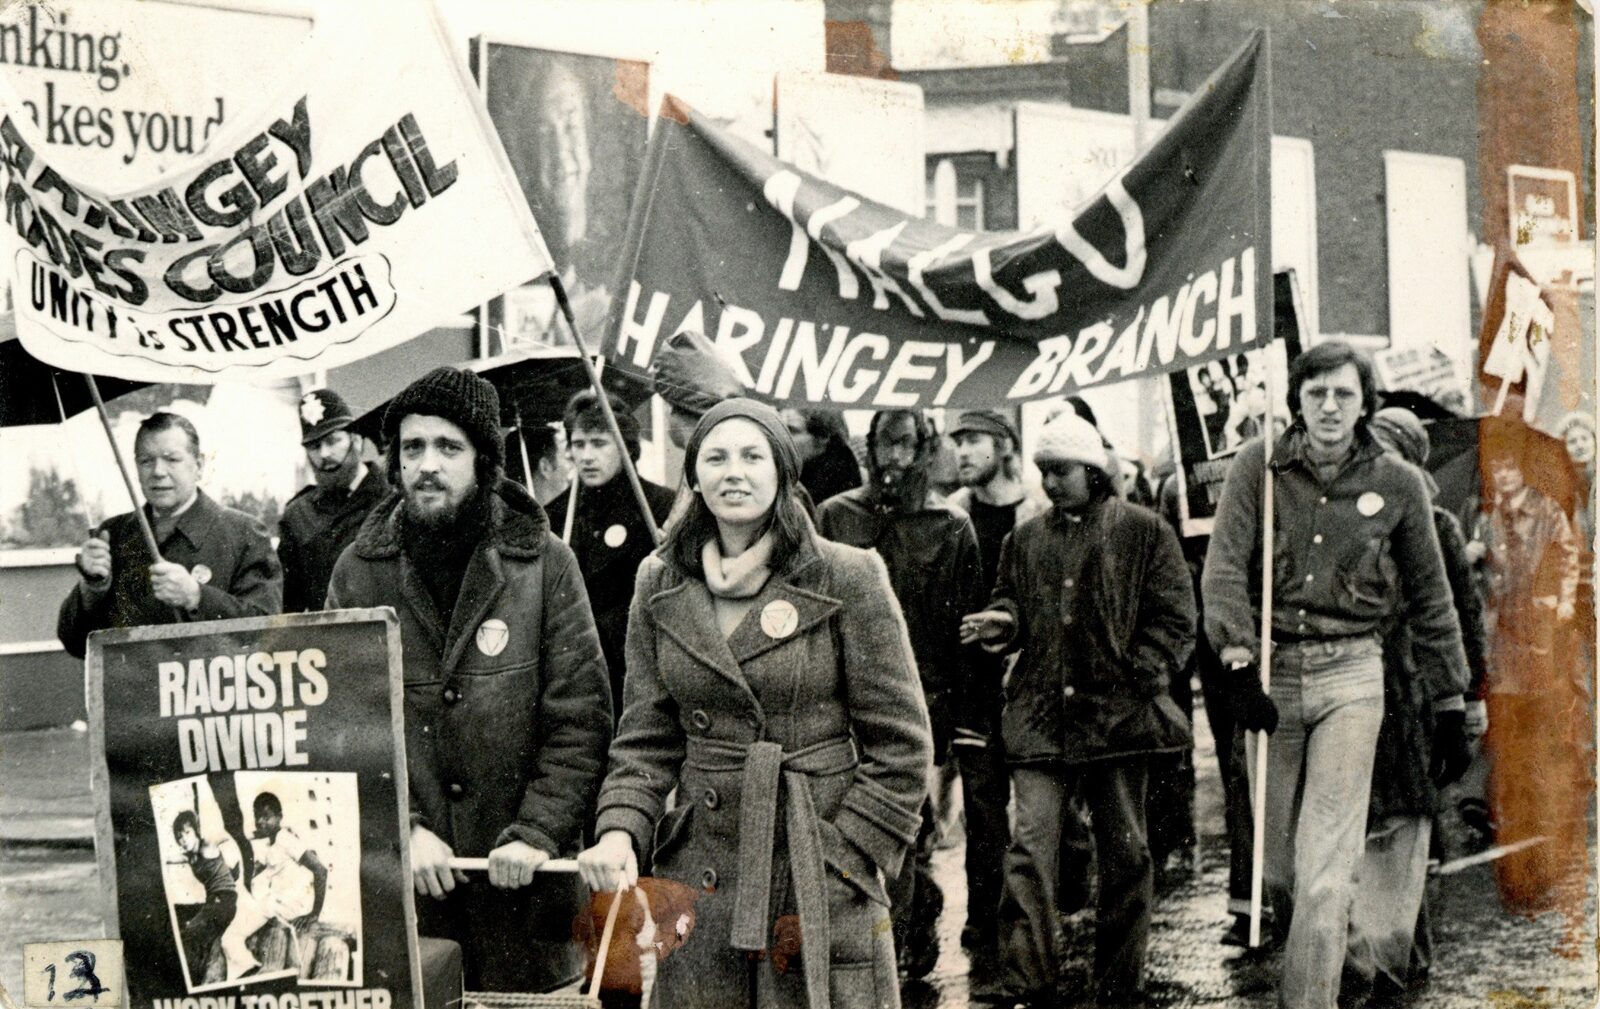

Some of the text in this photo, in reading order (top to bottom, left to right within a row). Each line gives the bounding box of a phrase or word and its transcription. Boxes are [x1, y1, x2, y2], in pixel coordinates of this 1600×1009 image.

[122, 110, 194, 165] you
[163, 112, 459, 302] COUNCIL
[168, 263, 379, 352] STRENGTH
[1006, 246, 1257, 399] BRANCH
[158, 648, 329, 718] RACISTS
[177, 709, 310, 774] DIVIDE
